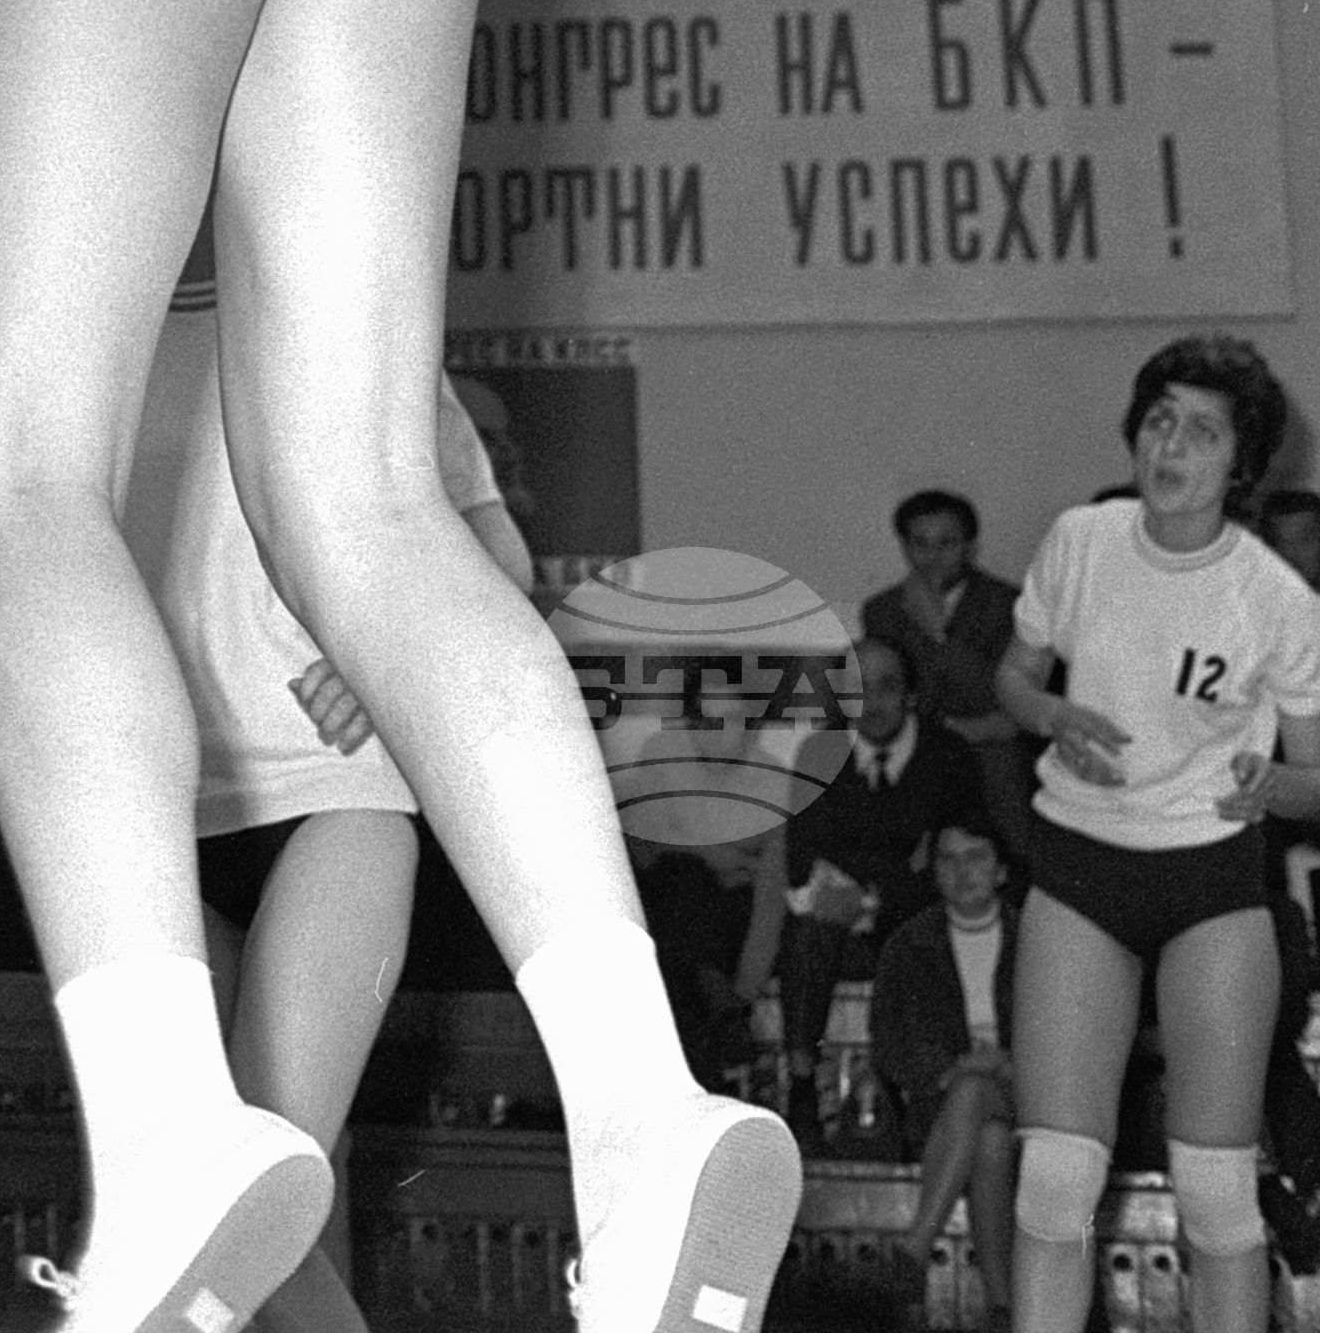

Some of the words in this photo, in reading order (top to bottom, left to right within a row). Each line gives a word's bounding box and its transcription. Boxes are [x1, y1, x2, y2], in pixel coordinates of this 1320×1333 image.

[468, 16, 721, 121] ОНГРЕС
[776, 12, 863, 115] НА
[453, 166, 701, 270] ОРТНИ
[783, 156, 1098, 266] УСПЕХИ
[1175, 646, 1228, 704] 12
